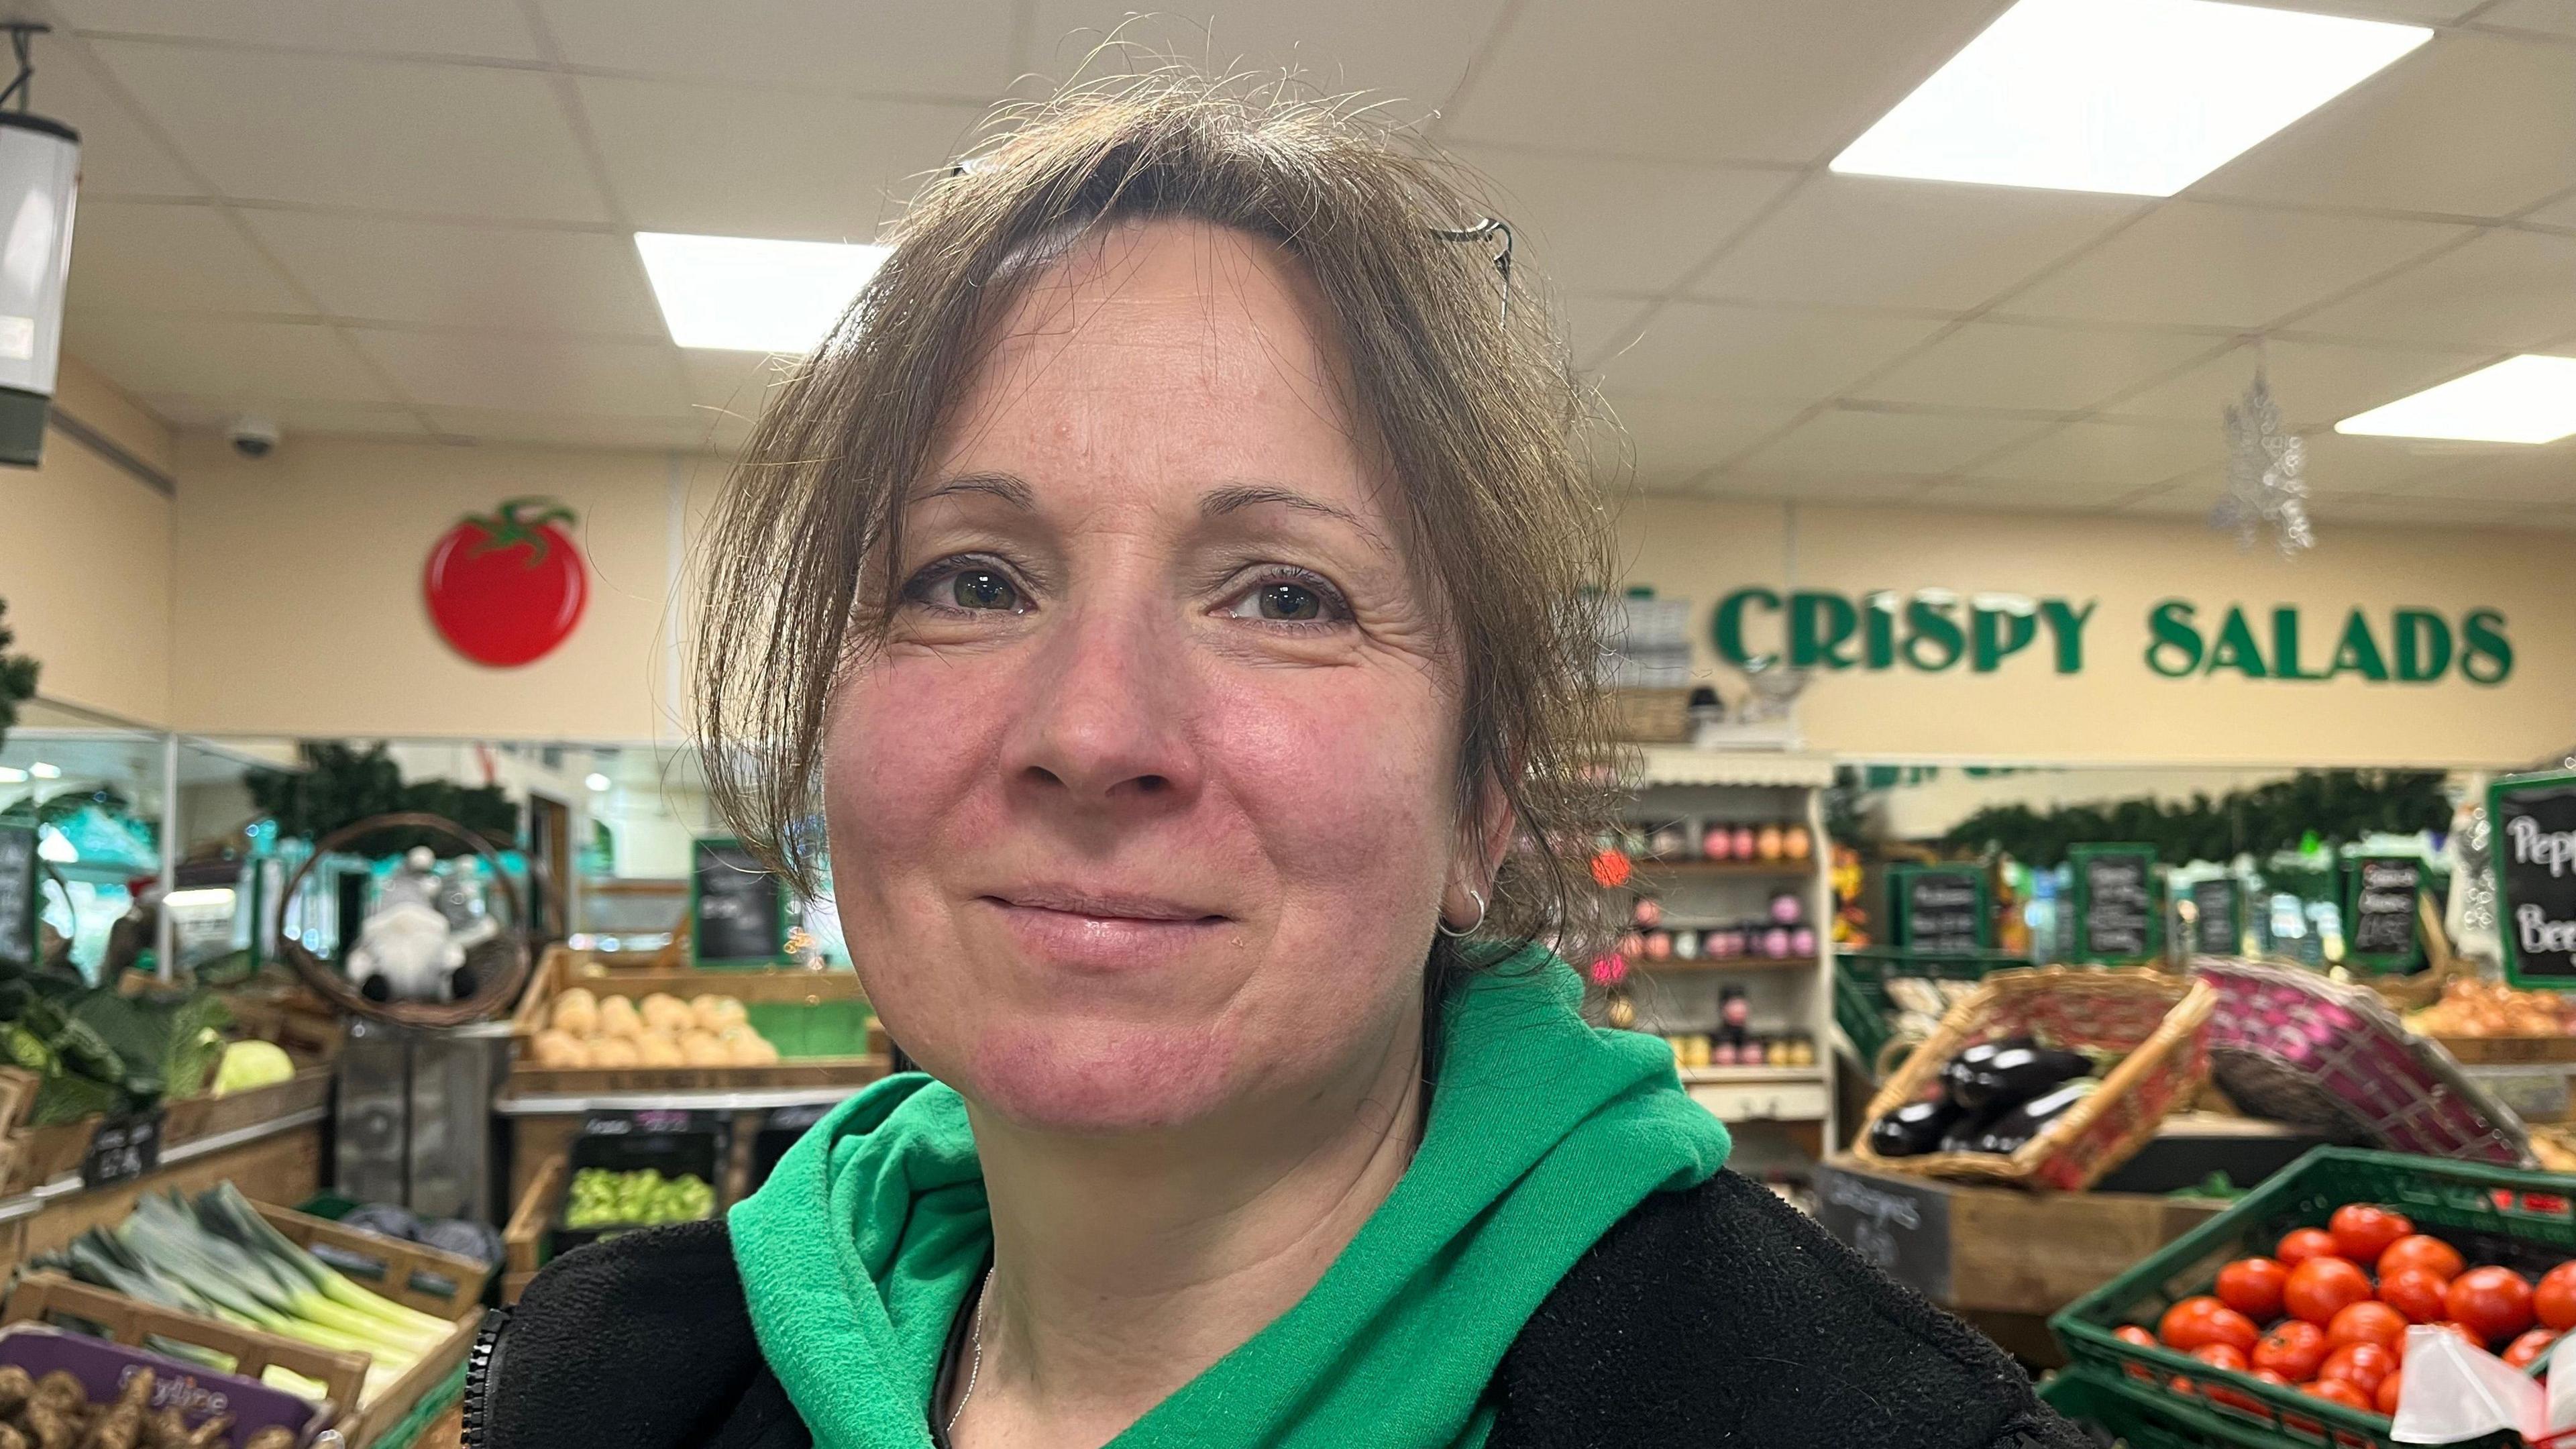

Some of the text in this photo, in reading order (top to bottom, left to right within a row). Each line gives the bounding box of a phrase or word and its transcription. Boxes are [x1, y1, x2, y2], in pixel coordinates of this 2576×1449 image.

[1713, 588, 2513, 684] CRISPY SALADS
[2506, 814, 2576, 878] Pep
